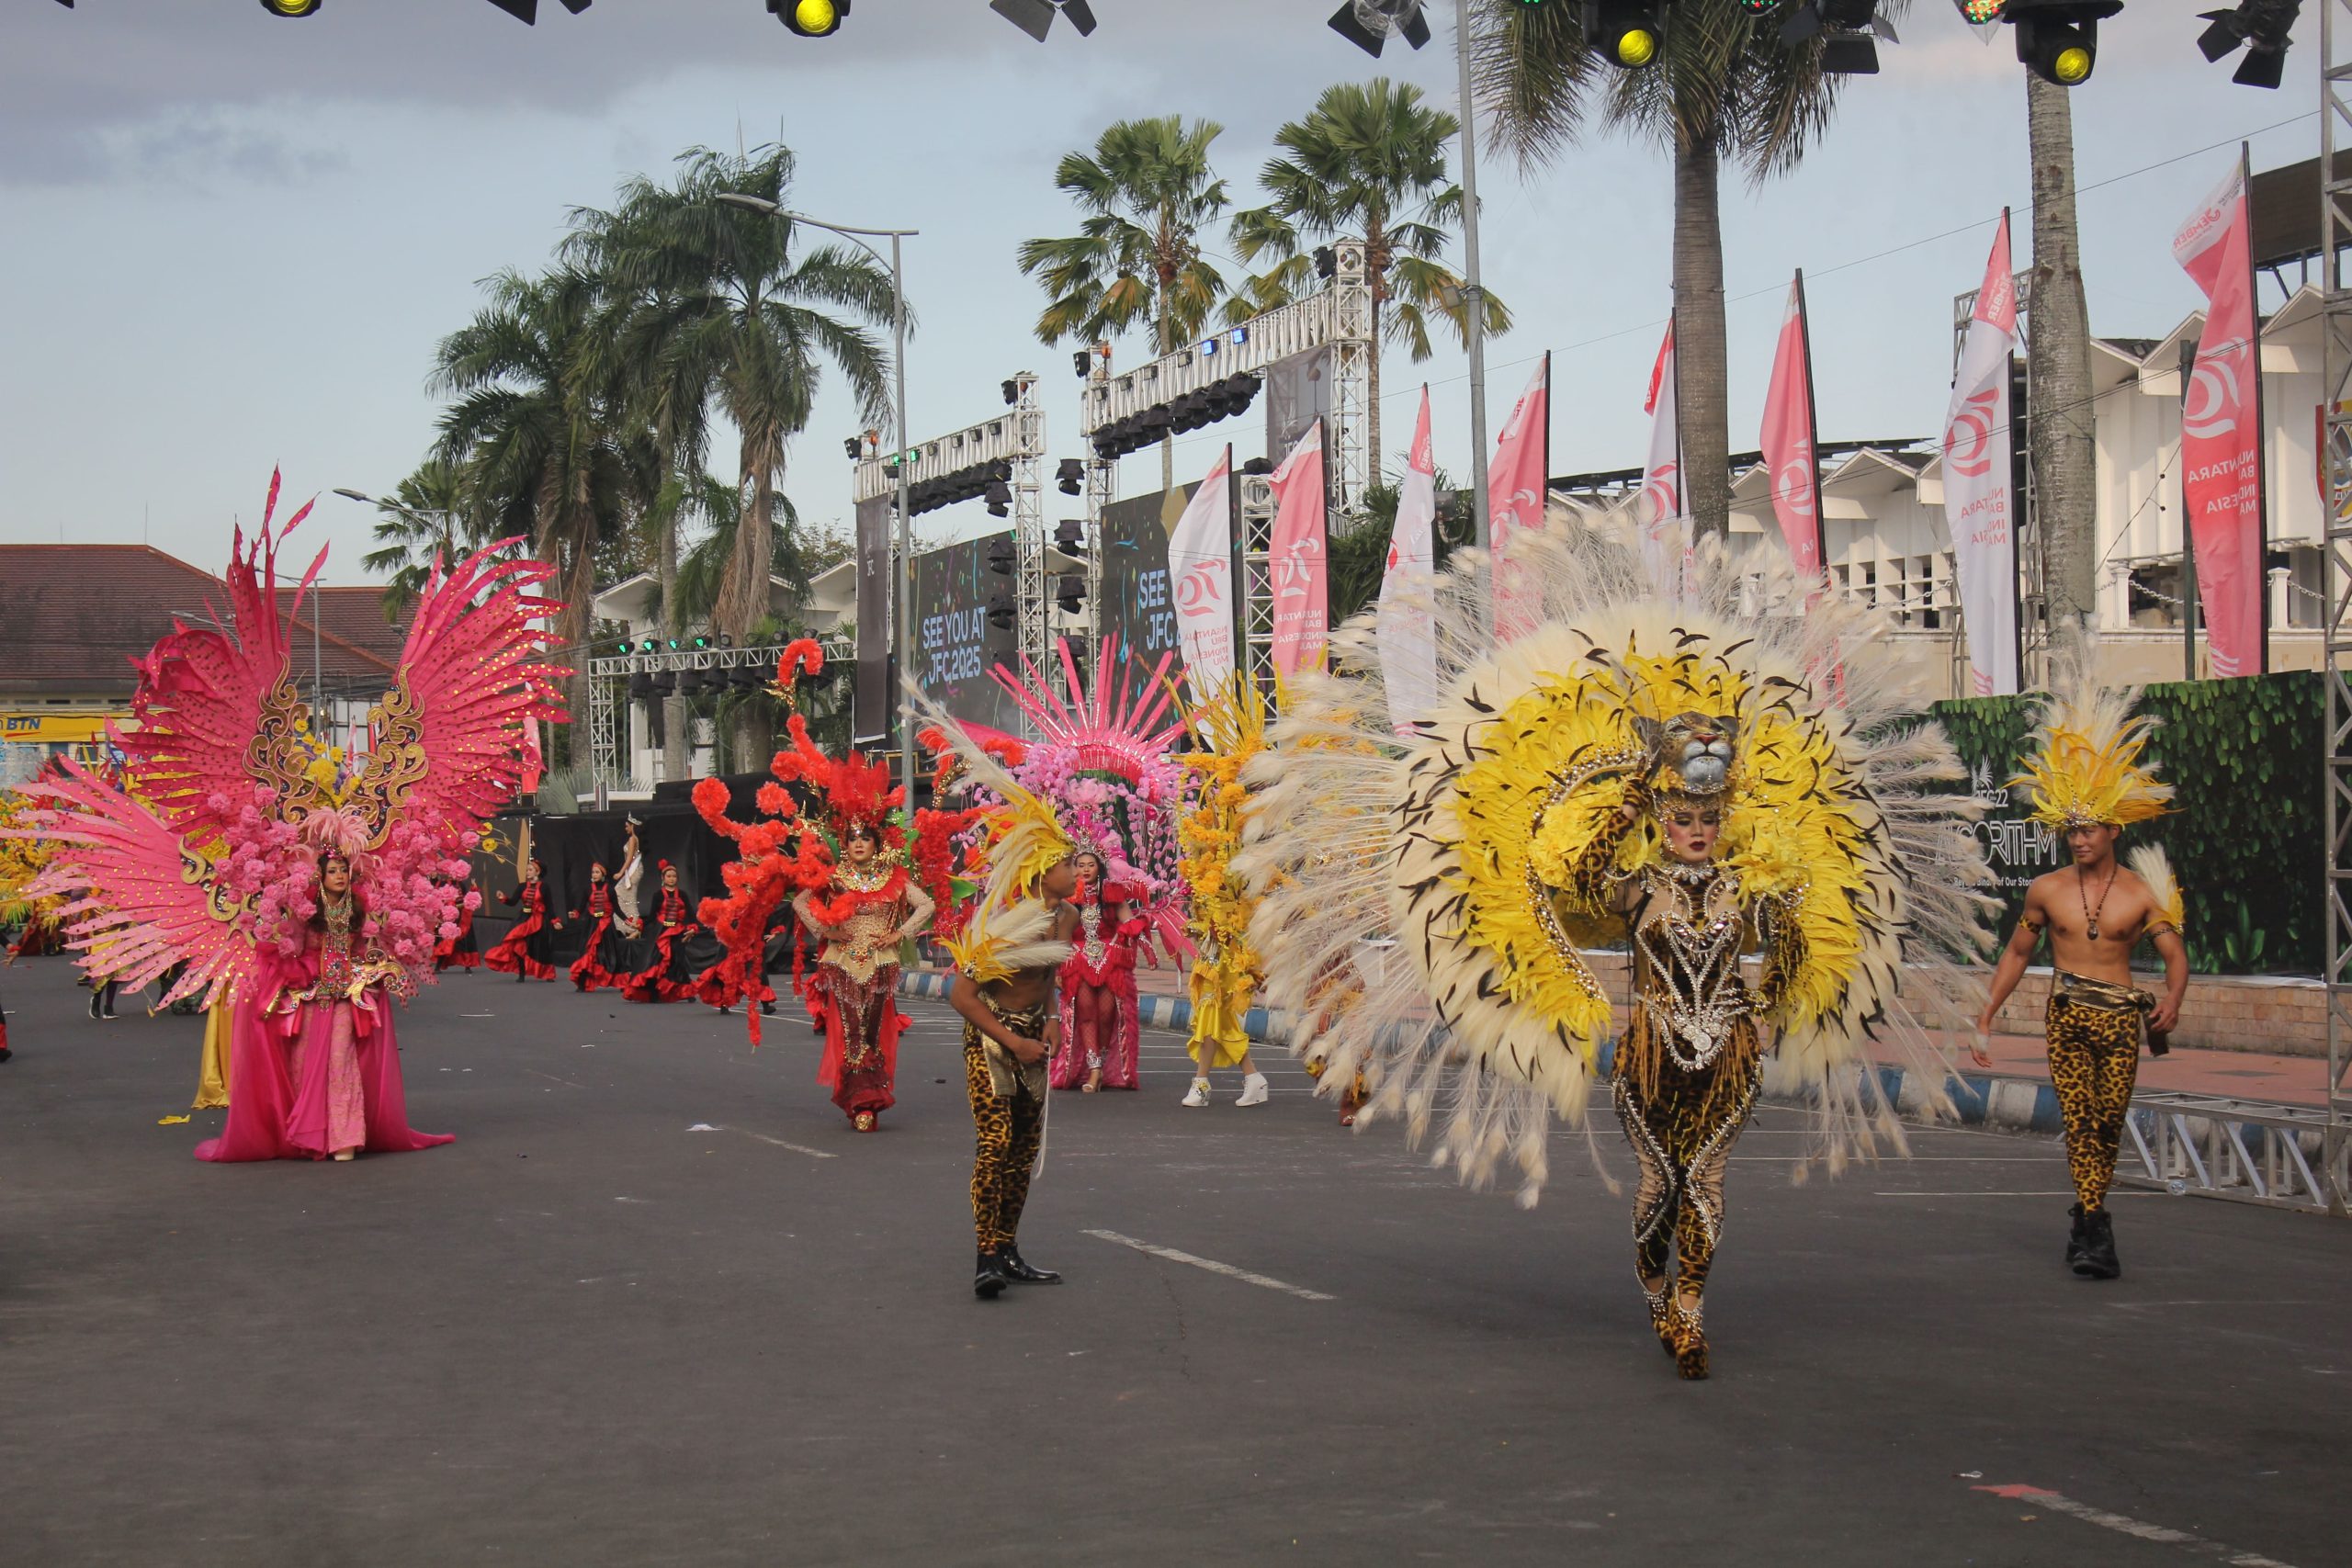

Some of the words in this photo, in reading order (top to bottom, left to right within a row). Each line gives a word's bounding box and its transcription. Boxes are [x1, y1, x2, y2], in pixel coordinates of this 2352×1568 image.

[1139, 570, 1166, 609] SEE
[922, 615, 944, 649] SEE
[944, 610, 968, 645] YOU
[971, 606, 986, 642] AT
[1147, 611, 1174, 650] JFC
[928, 650, 952, 684] JFC
[952, 645, 981, 680] 2025
[6, 718, 41, 730] BTN
[2005, 876, 2018, 887] Our
[2018, 876, 2034, 886] Stor
